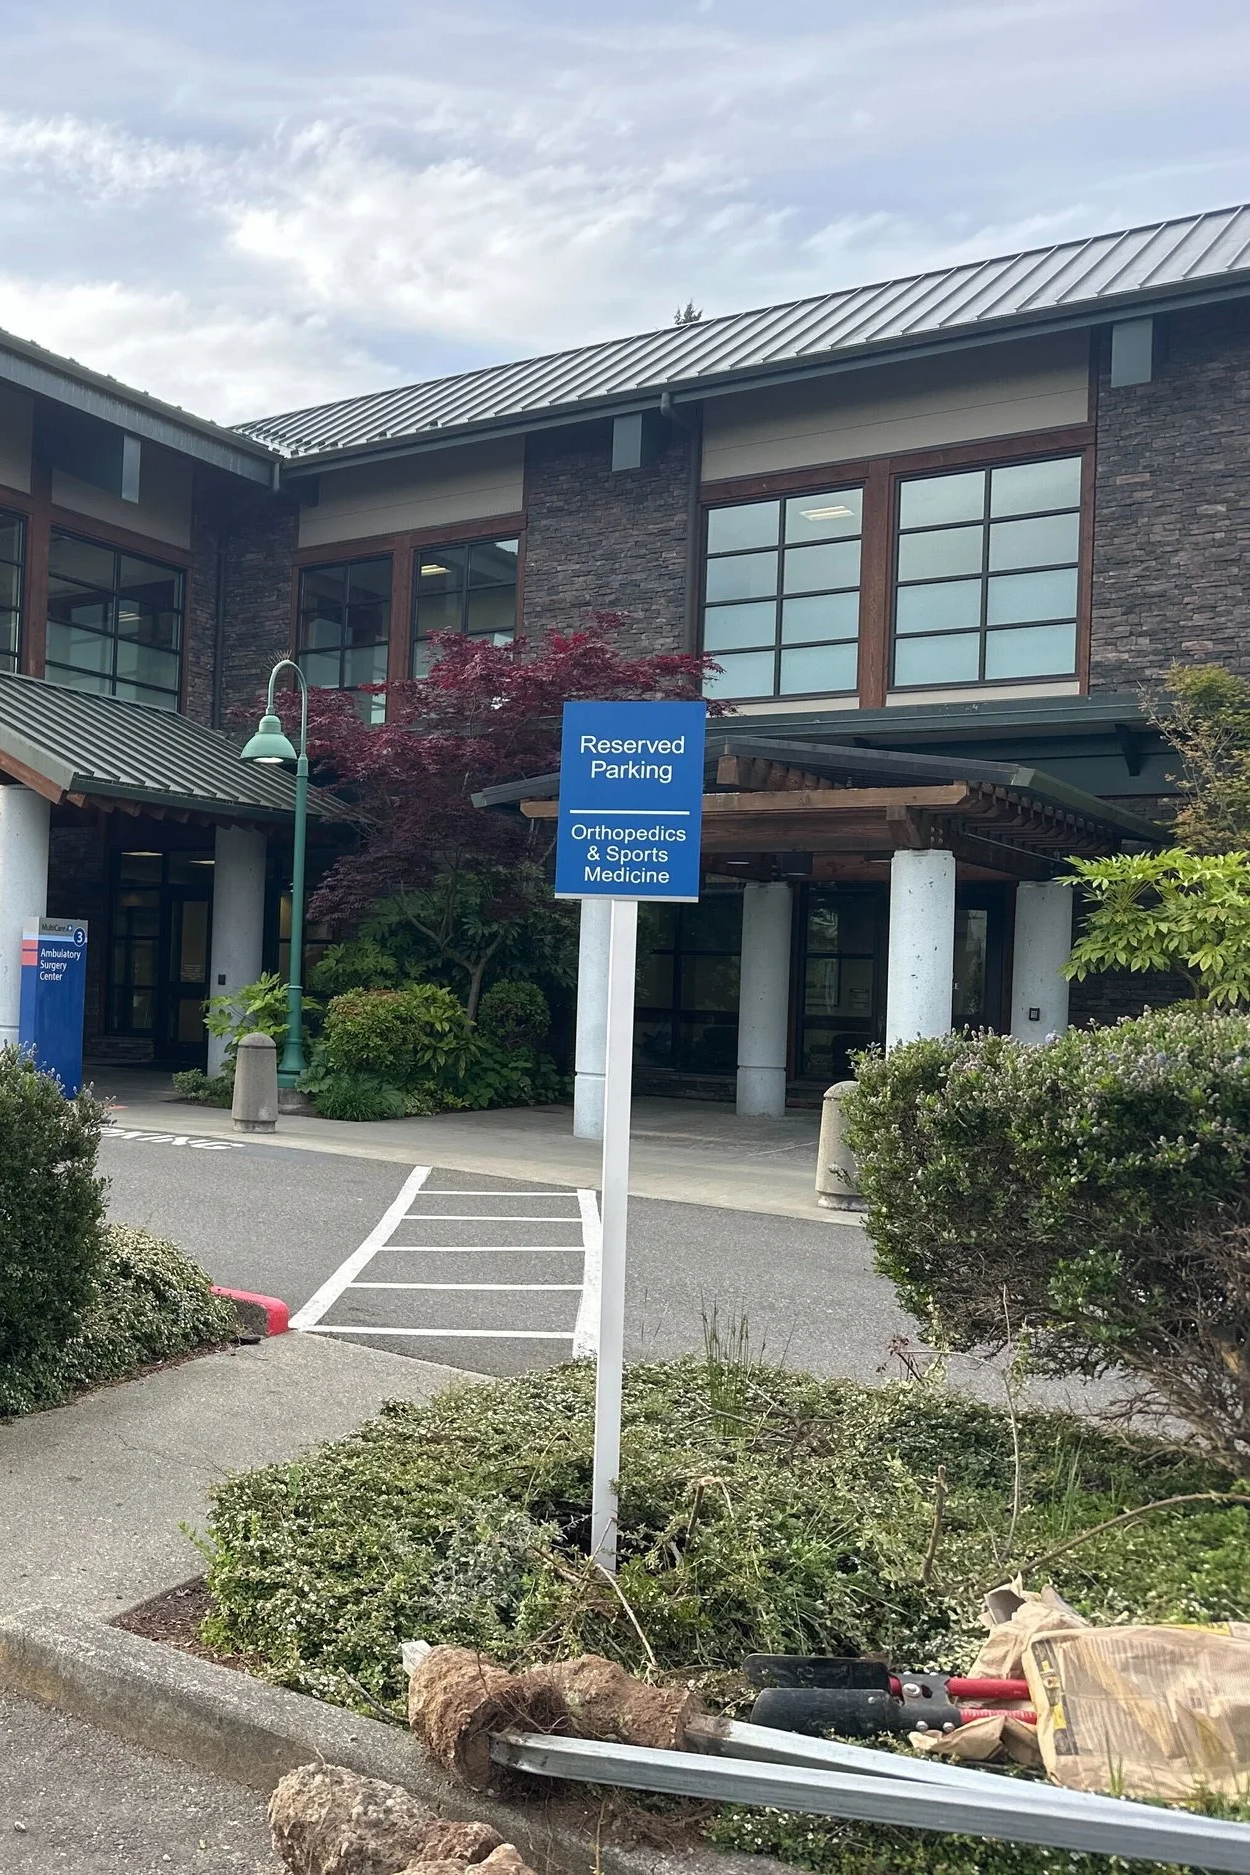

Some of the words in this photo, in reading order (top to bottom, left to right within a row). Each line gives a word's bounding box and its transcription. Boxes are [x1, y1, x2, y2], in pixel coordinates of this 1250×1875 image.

[580, 735, 685, 754] Reserved
[590, 760, 673, 784] Parking
[571, 824, 687, 844] Orthopedics
[586, 845, 601, 861] &
[606, 845, 669, 865] Sports
[584, 866, 670, 884] Medicine
[77, 931, 83, 943] 3
[40, 948, 81, 960] Ambulatory
[40, 960, 67, 972] Surgery
[39, 971, 63, 981] Center
